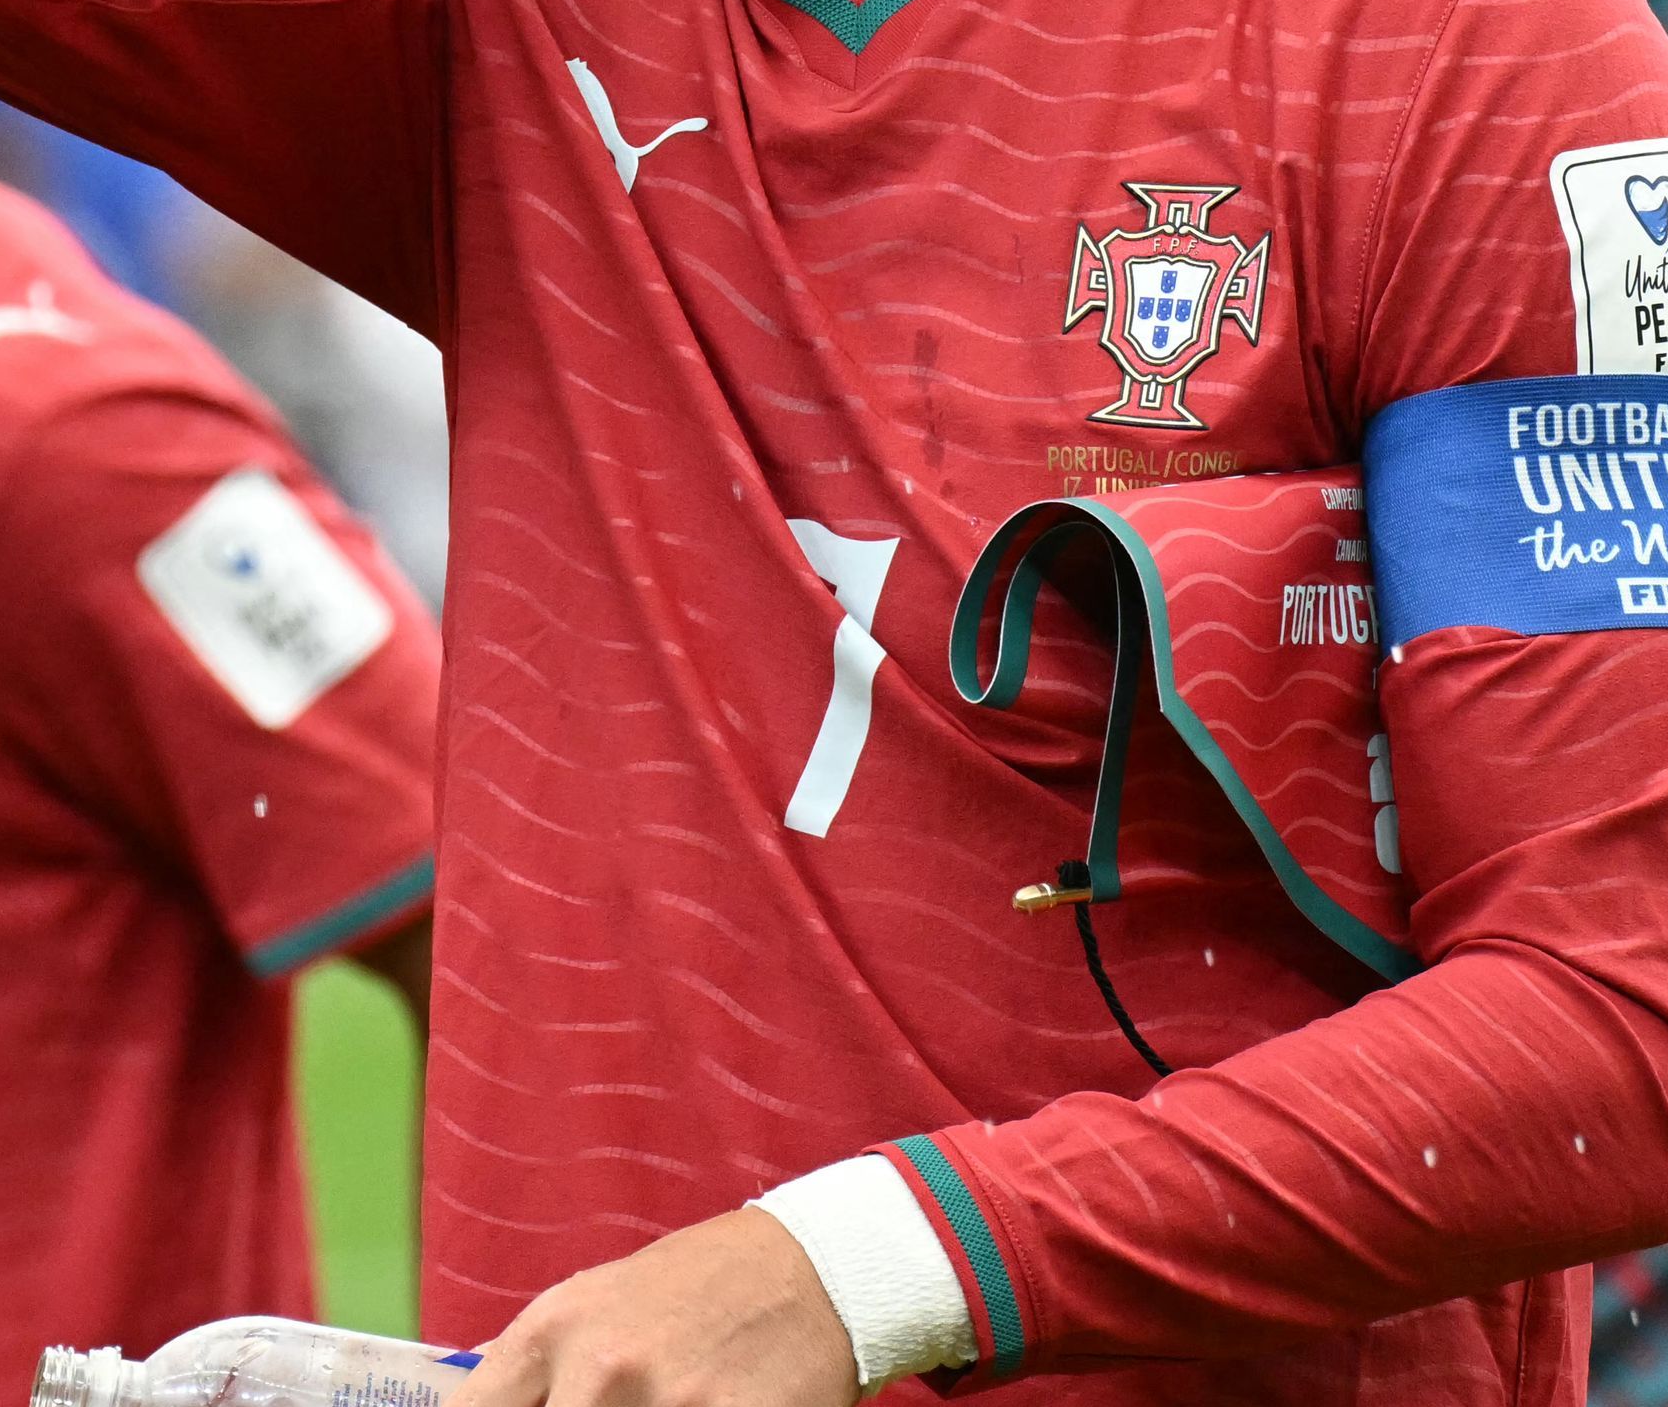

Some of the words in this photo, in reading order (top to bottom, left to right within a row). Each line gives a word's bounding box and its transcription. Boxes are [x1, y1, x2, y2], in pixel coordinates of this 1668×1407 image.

[1096, 477, 1163, 495] JUN
[1321, 488, 1367, 510] CAMPEON
[1518, 520, 1620, 572] the
[784, 518, 901, 839] 7
